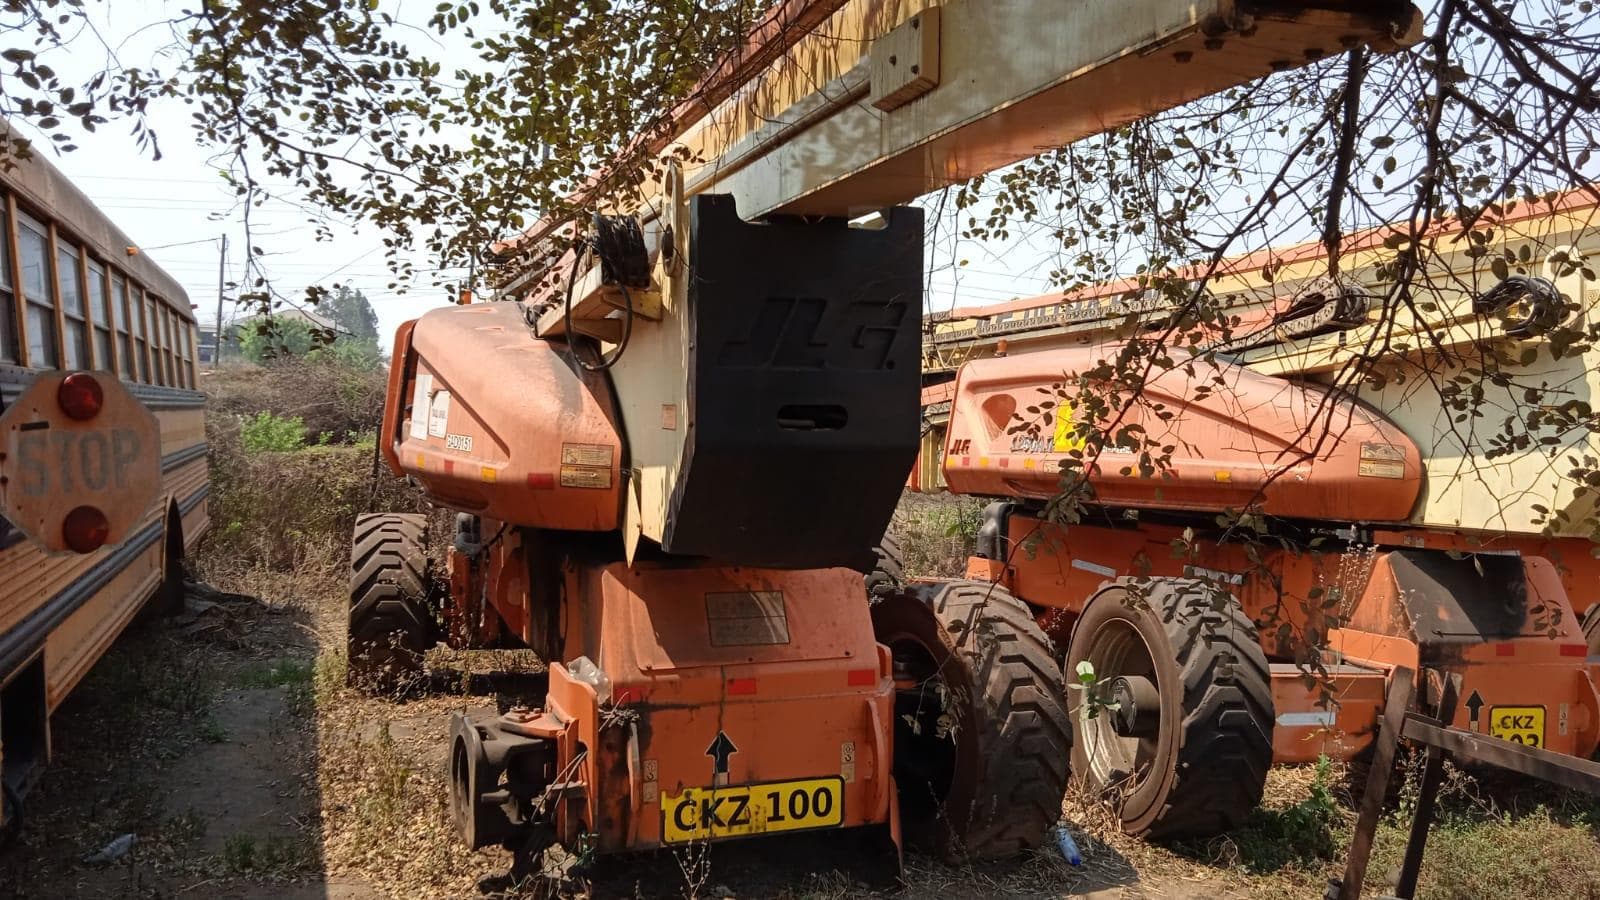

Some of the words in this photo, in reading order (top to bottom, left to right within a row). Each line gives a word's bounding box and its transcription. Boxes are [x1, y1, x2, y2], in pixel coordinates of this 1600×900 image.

[17, 429, 140, 497] STOP
[1501, 715, 1535, 729] CKZ
[673, 795, 750, 831] CKZ
[767, 786, 833, 822] 100
